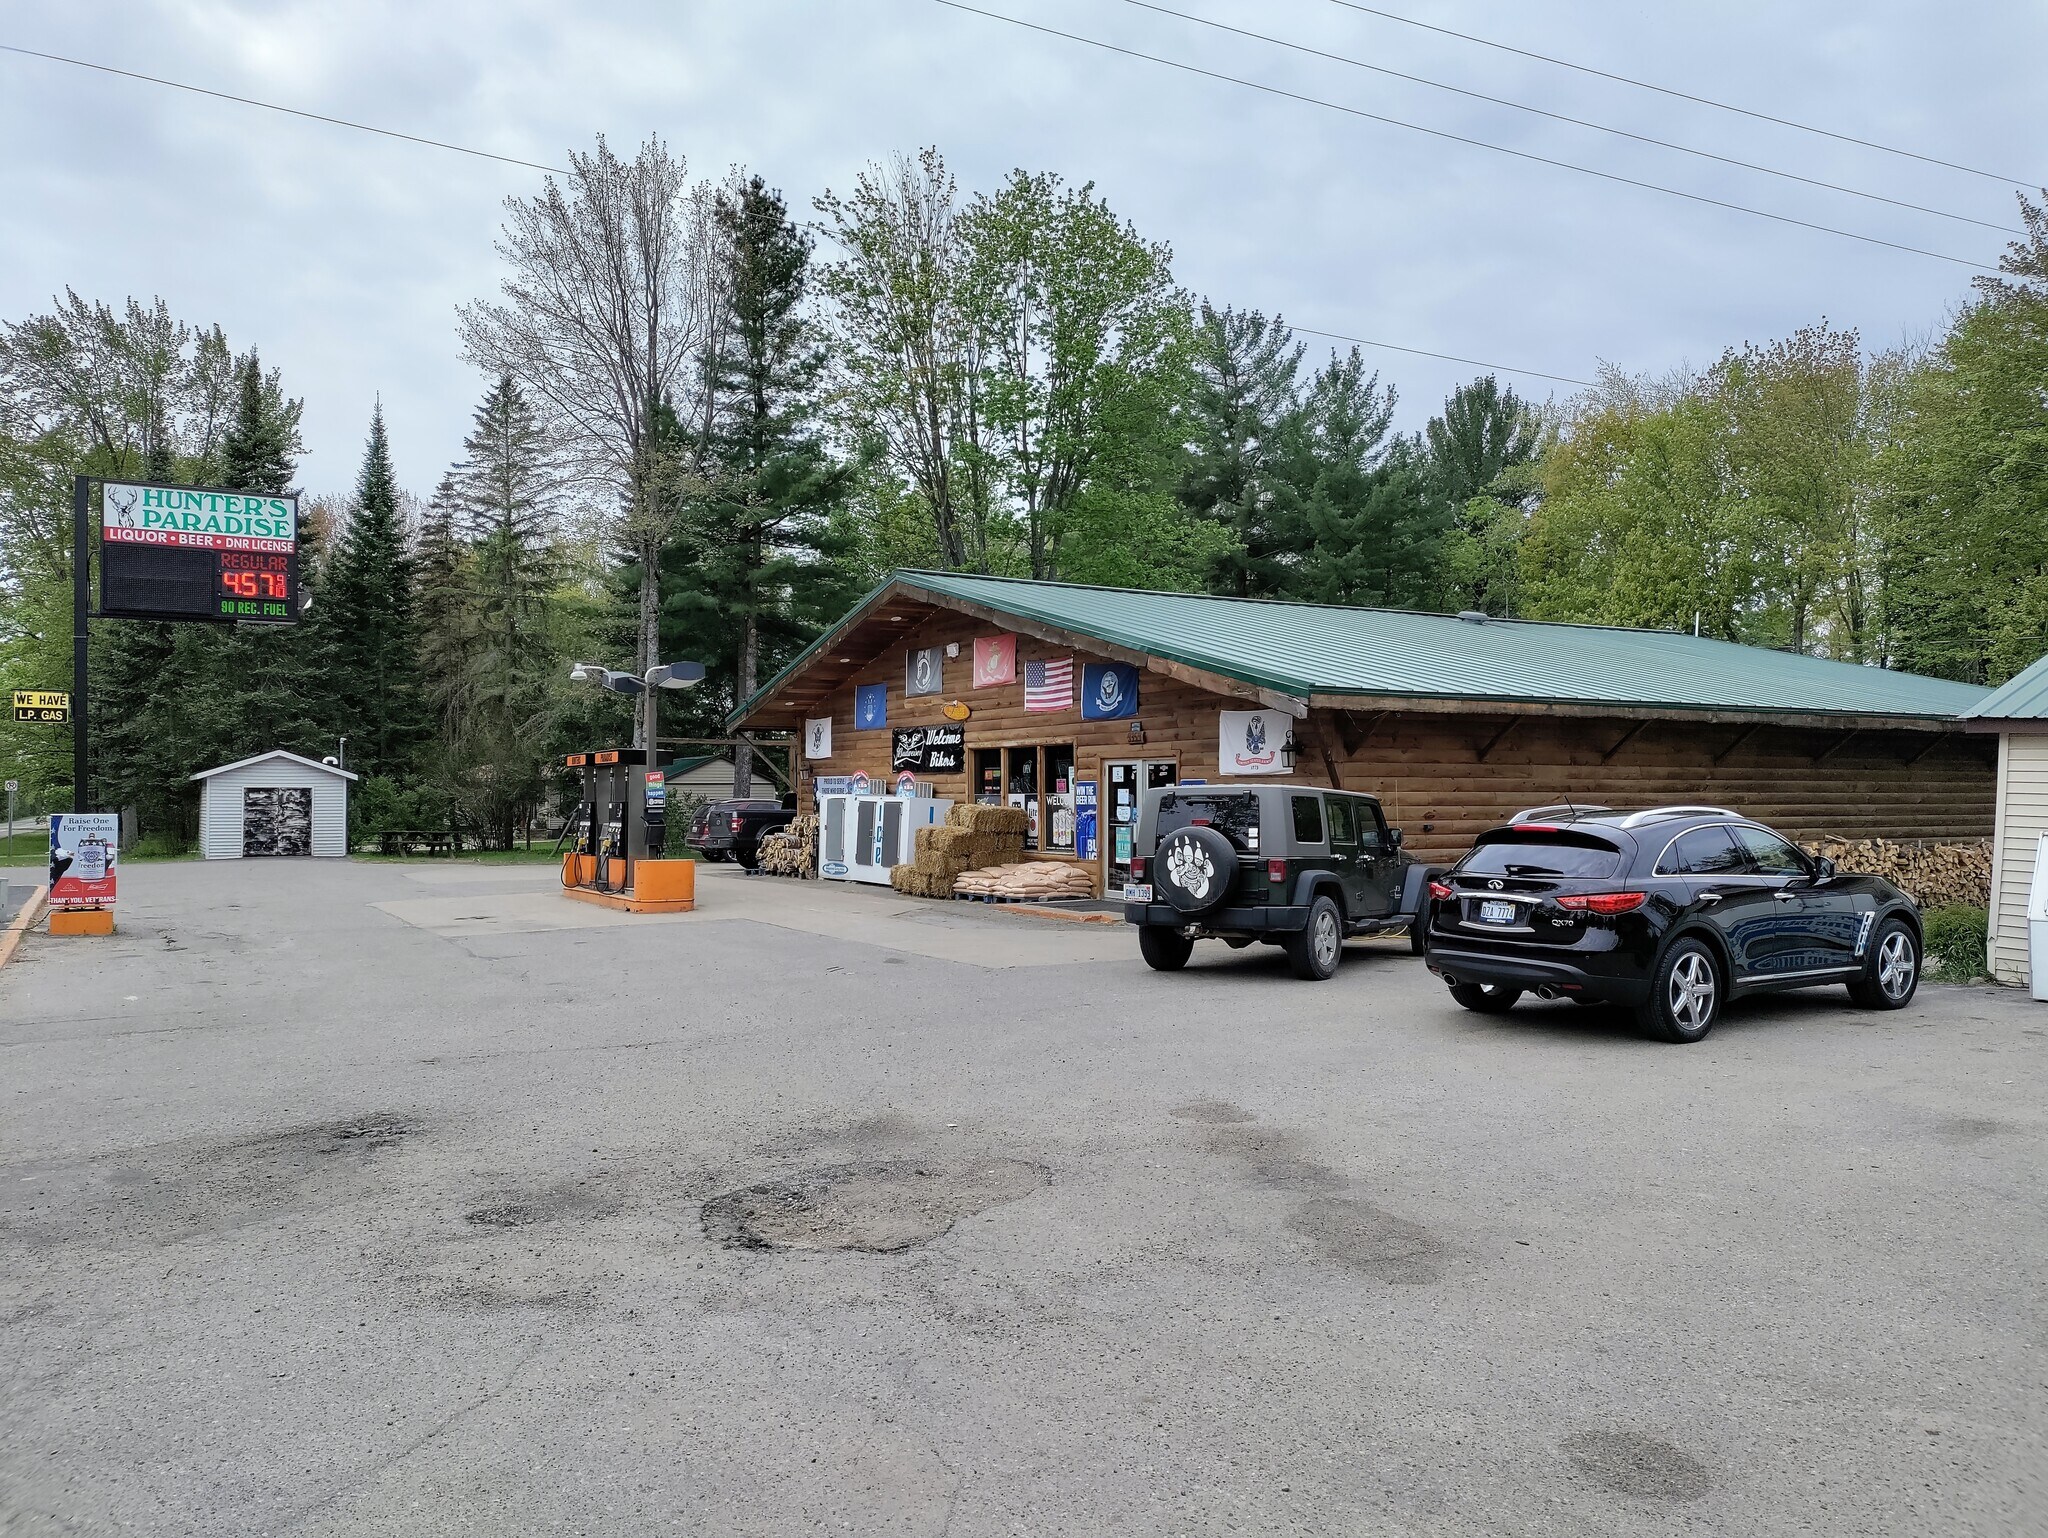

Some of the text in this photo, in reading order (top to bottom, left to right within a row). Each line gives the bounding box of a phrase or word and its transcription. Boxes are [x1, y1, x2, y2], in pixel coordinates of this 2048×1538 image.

[142, 488, 288, 518] HUNTER'S
[142, 509, 292, 539] PARADISE
[109, 528, 293, 552] LIQUOR BEER DNR LICENSE
[221, 553, 288, 571] REGULAR
[223, 571, 274, 596] 4.57
[221, 601, 288, 616] 90 REC. FUEL
[16, 694, 67, 706] WE HAVE
[19, 709, 63, 721] L.P. GAS
[925, 729, 962, 746] Welcome
[929, 751, 956, 768] Bikers
[649, 773, 661, 781] good
[648, 781, 662, 789] things
[647, 790, 664, 798] happen
[1076, 795, 1087, 805] BEER
[68, 817, 110, 825] Raise One
[1497, 907, 1514, 918] 7774
[1551, 919, 1574, 927] QX70
